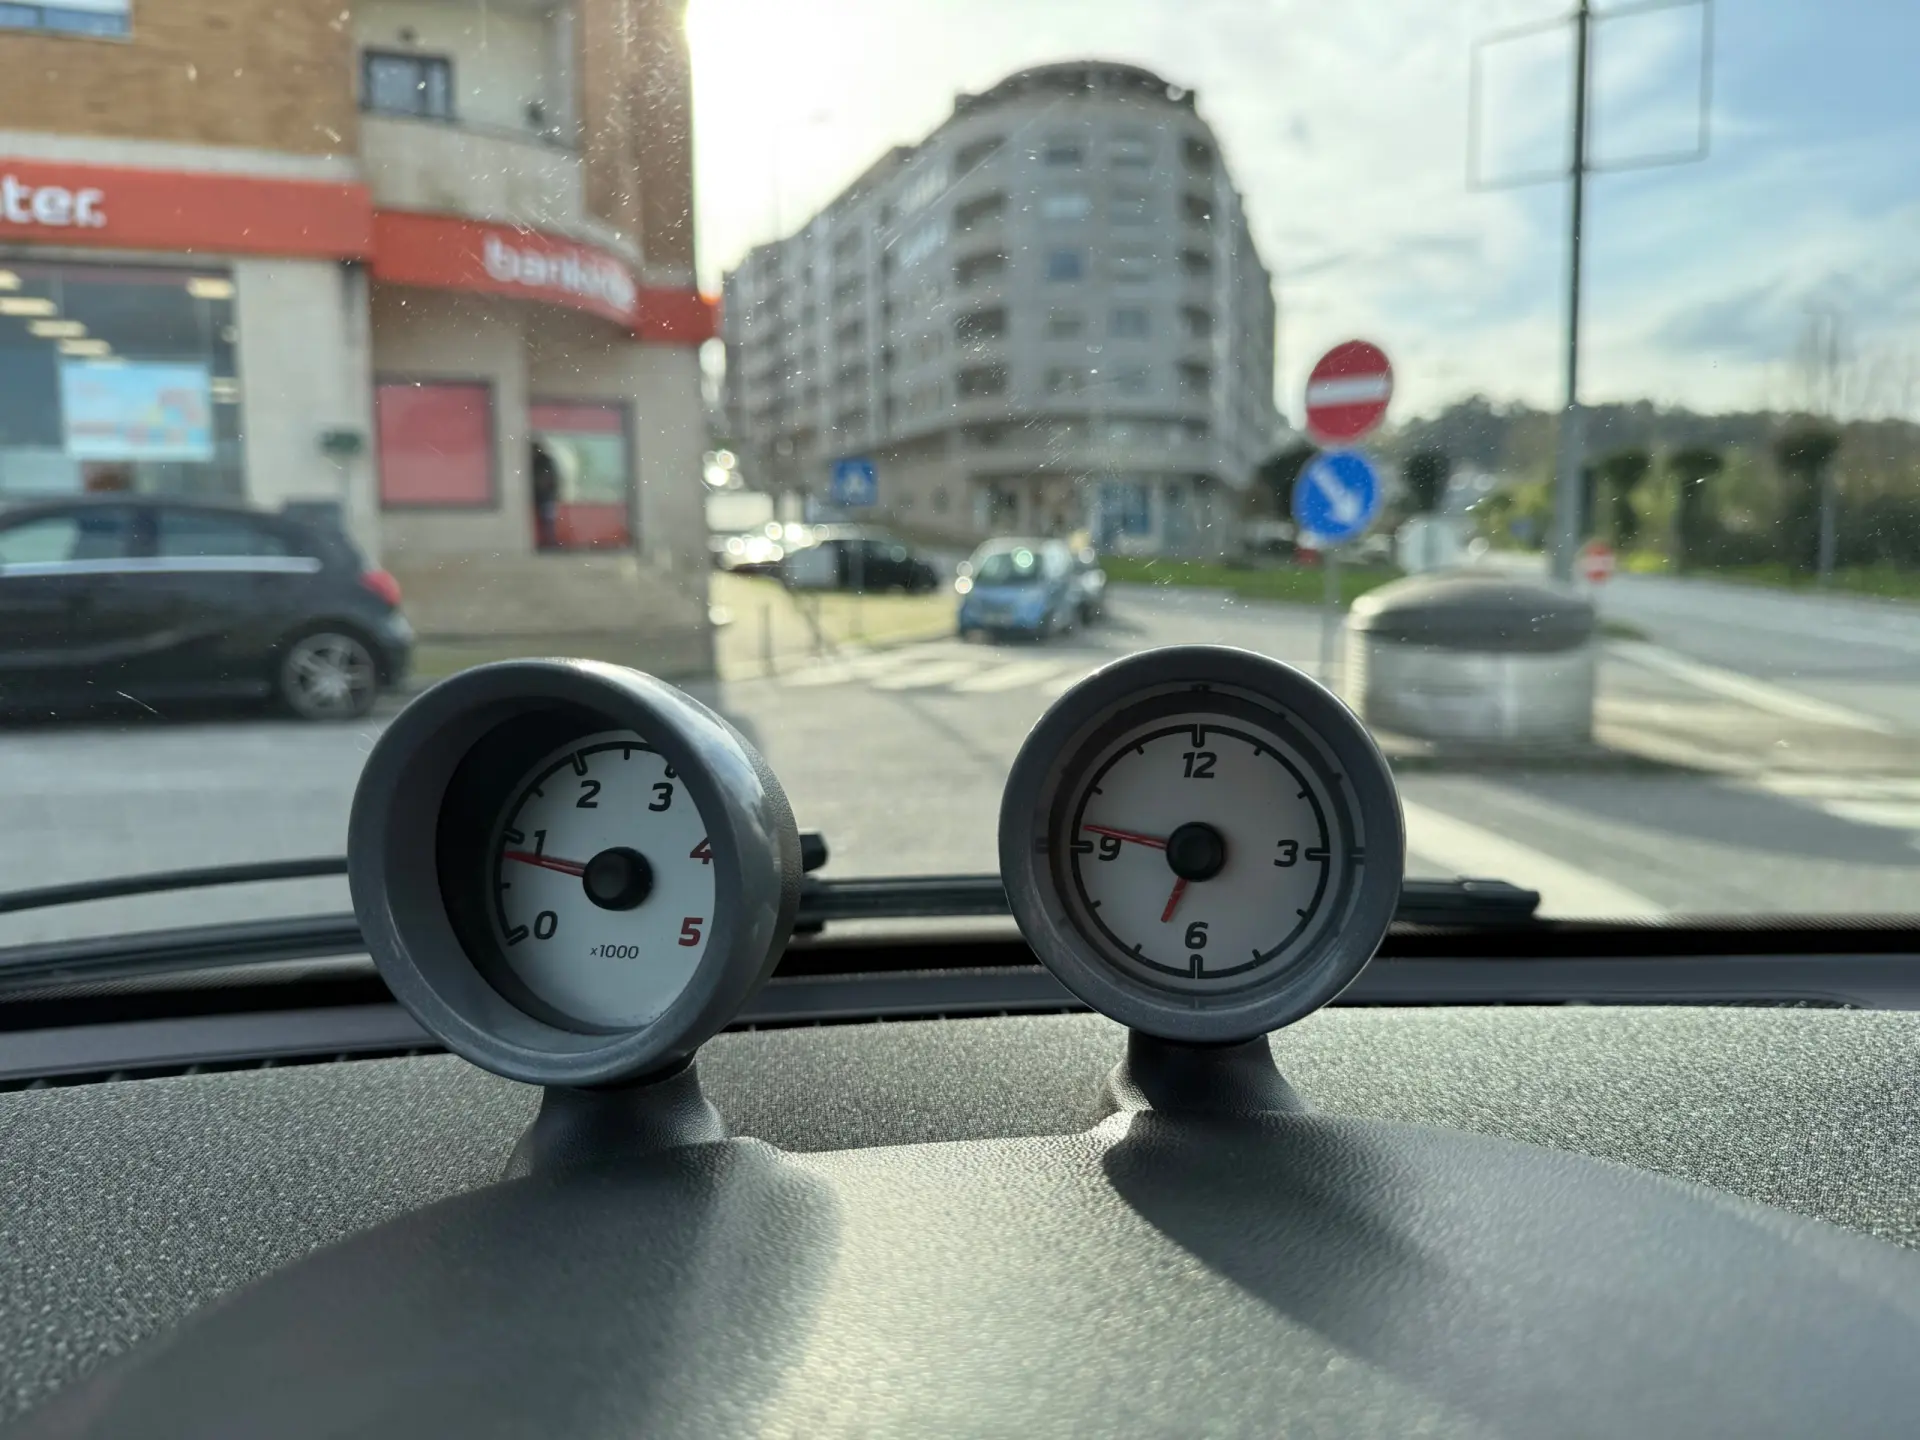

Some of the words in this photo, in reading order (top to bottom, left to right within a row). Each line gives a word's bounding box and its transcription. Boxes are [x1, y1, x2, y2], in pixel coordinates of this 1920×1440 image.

[1182, 751, 1217, 779] 12
[577, 780, 601, 809] 2
[648, 782, 673, 812] 3
[533, 829, 547, 857] 1
[690, 837, 713, 865] 4
[1098, 835, 1122, 861] 9
[1273, 839, 1299, 867] 3
[533, 910, 558, 940] 0
[678, 917, 704, 947] 5
[1185, 921, 1208, 950] 6
[590, 944, 639, 959] x1000
